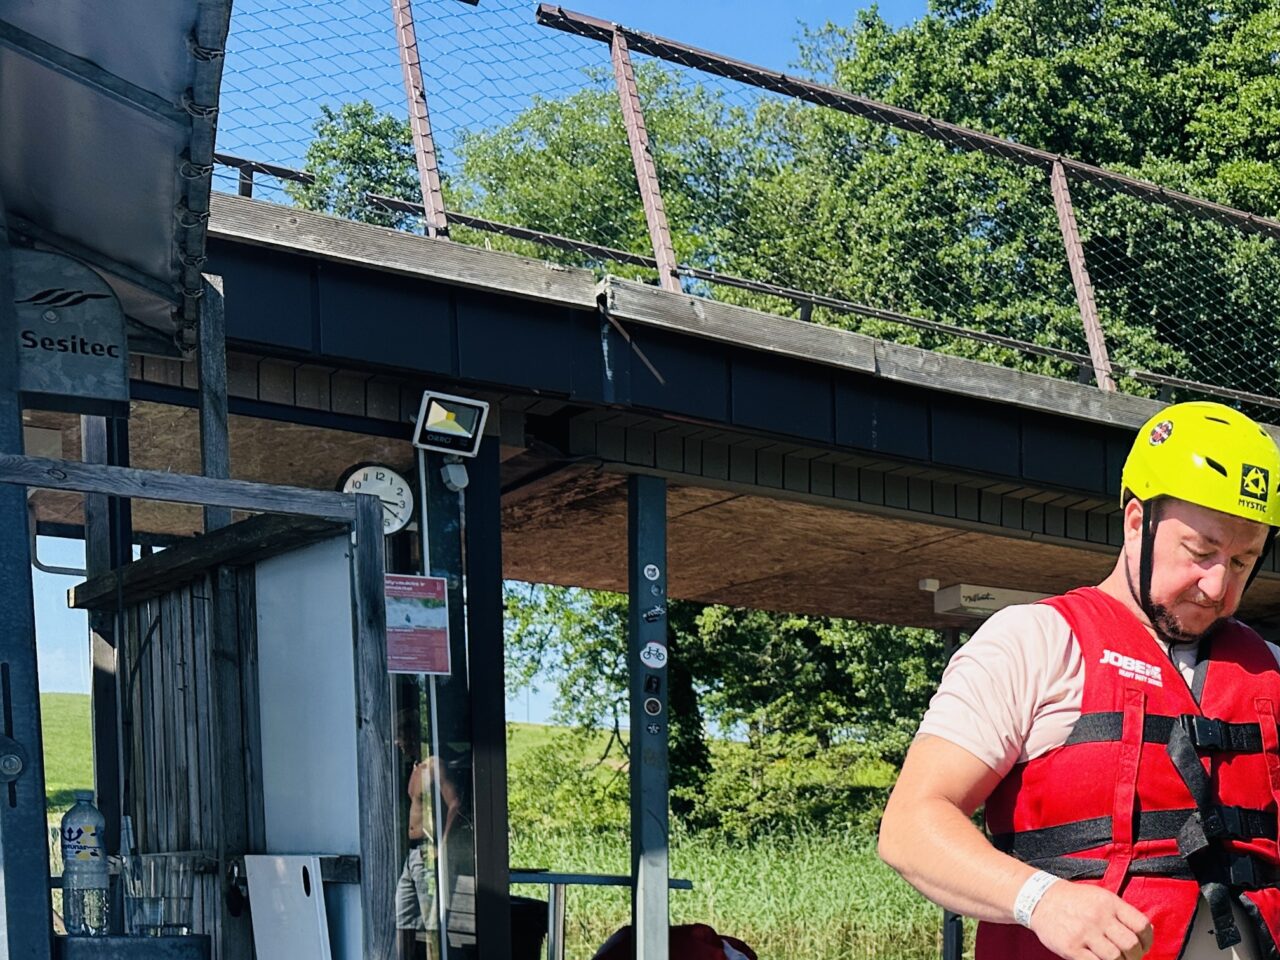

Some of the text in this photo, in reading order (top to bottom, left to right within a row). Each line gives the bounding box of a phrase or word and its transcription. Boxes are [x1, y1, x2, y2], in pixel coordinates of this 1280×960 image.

[21, 330, 119, 358] Sesitec
[363, 472, 369, 482] 11
[375, 471, 386, 481] 12
[352, 479, 362, 490] 10
[396, 487, 404, 497] 2
[399, 500, 406, 509] 3
[1238, 498, 1267, 513] MYSTIC
[1099, 649, 1147, 675] JOBE
